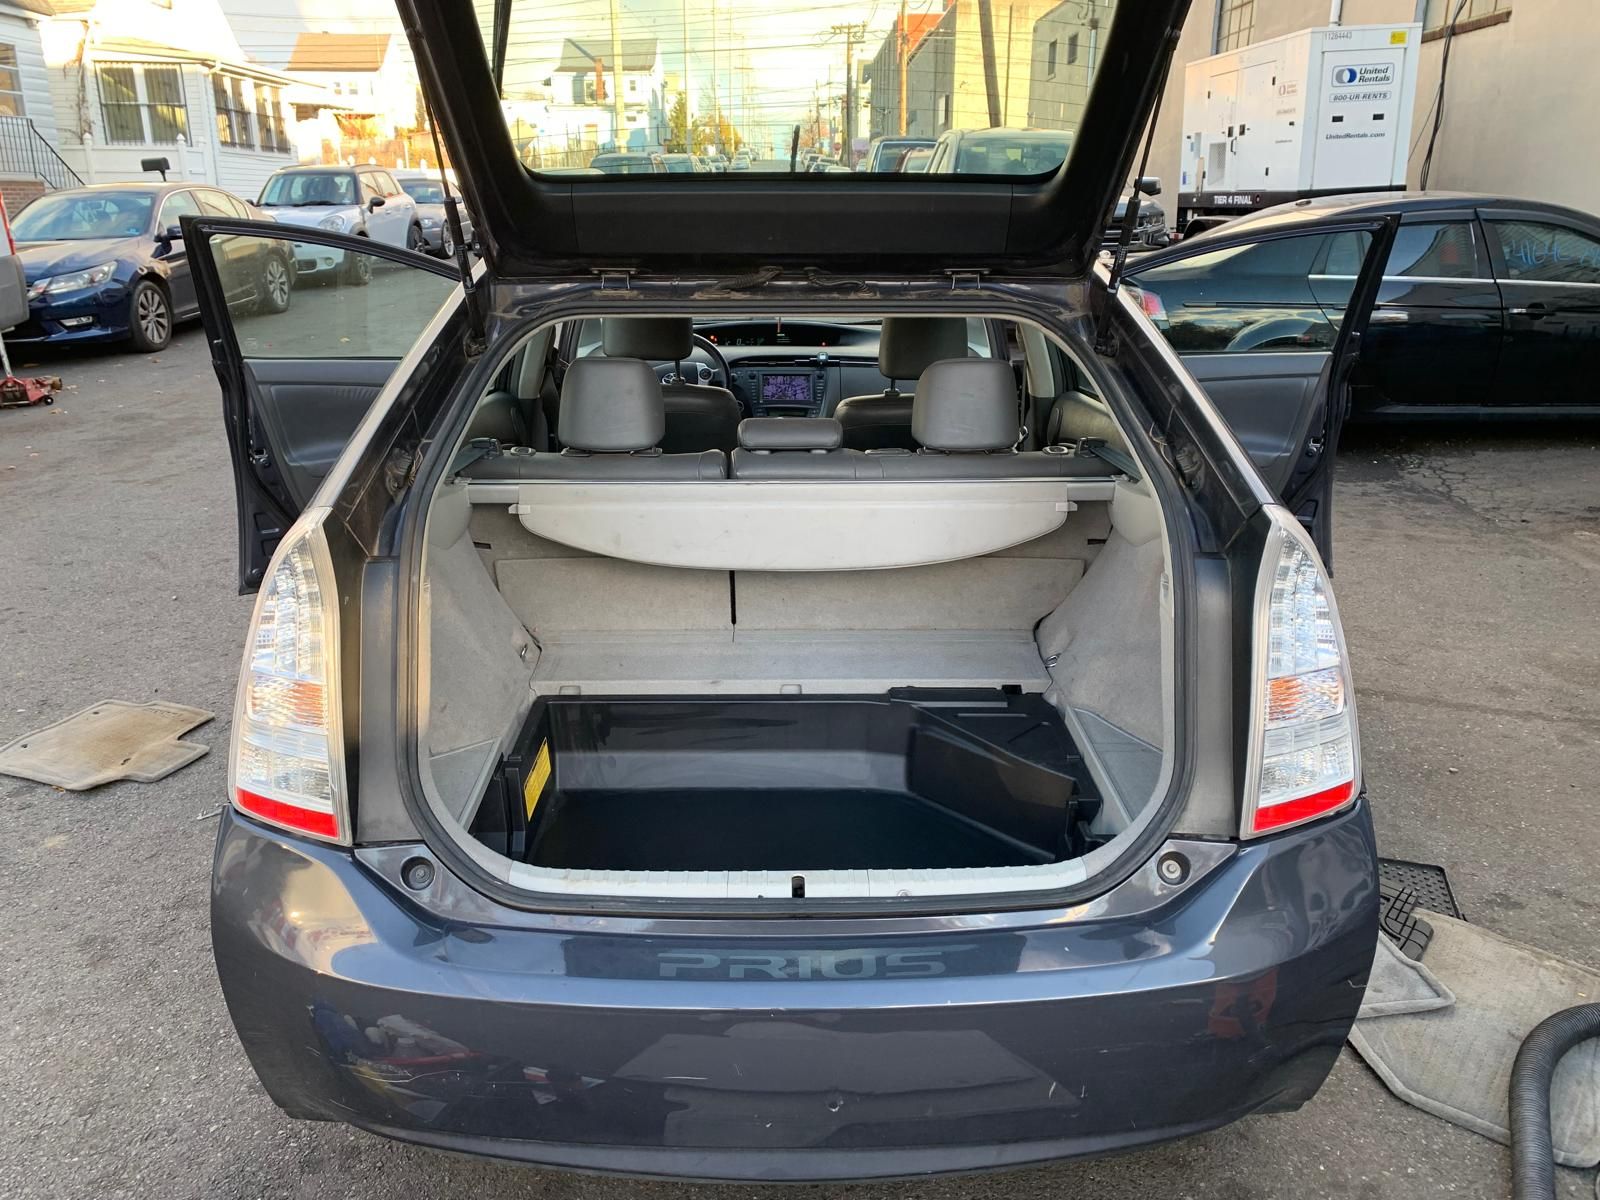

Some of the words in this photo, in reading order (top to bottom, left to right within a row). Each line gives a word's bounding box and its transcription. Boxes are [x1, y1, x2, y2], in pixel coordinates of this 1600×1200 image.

[1359, 66, 1389, 75] United
[1358, 74, 1390, 83] Rentals
[1214, 195, 1227, 204] TIER
[1228, 195, 1232, 204] 4
[1233, 195, 1252, 204] FINAL
[656, 951, 947, 980] PRIUS
